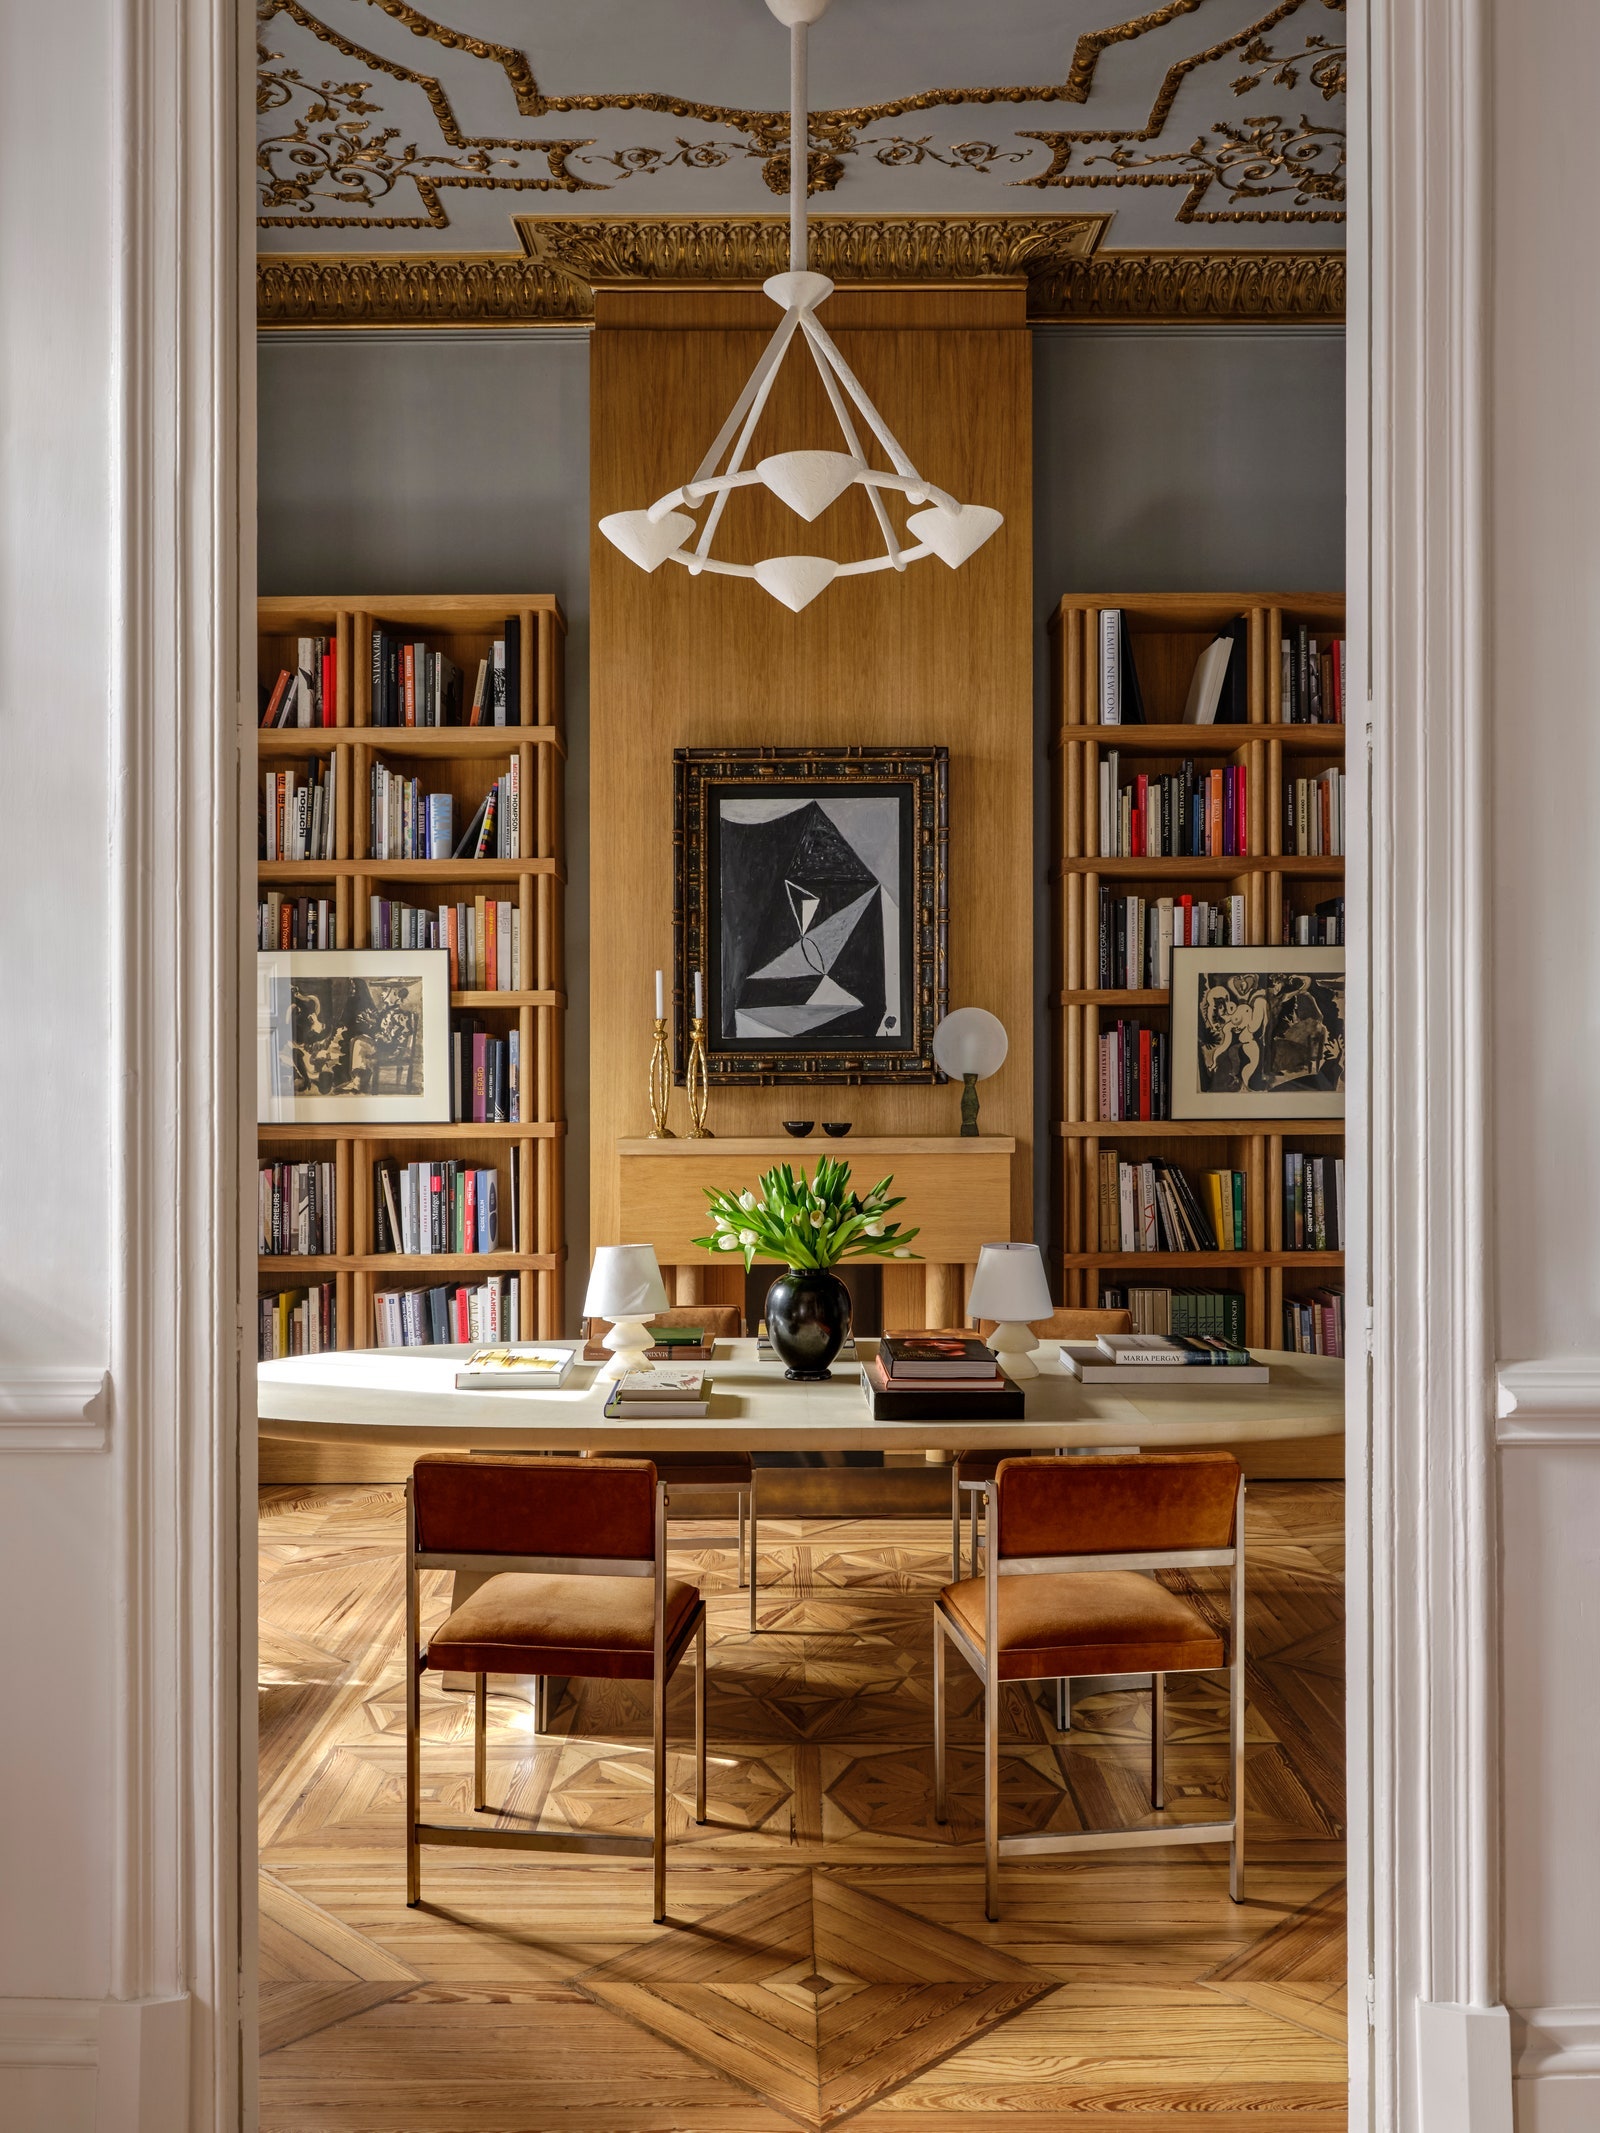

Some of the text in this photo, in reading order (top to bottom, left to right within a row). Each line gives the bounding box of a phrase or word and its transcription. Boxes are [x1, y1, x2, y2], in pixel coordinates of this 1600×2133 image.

[372, 634, 382, 685] PRONOVIAS
[1107, 616, 1115, 661] HELMUT
[1107, 665, 1115, 714] NEWTON
[299, 790, 307, 838] noguchi
[282, 908, 290, 927] Pierre
[272, 1193, 280, 1237] INTÉRIEURS
[470, 1301, 478, 1314] ALL
